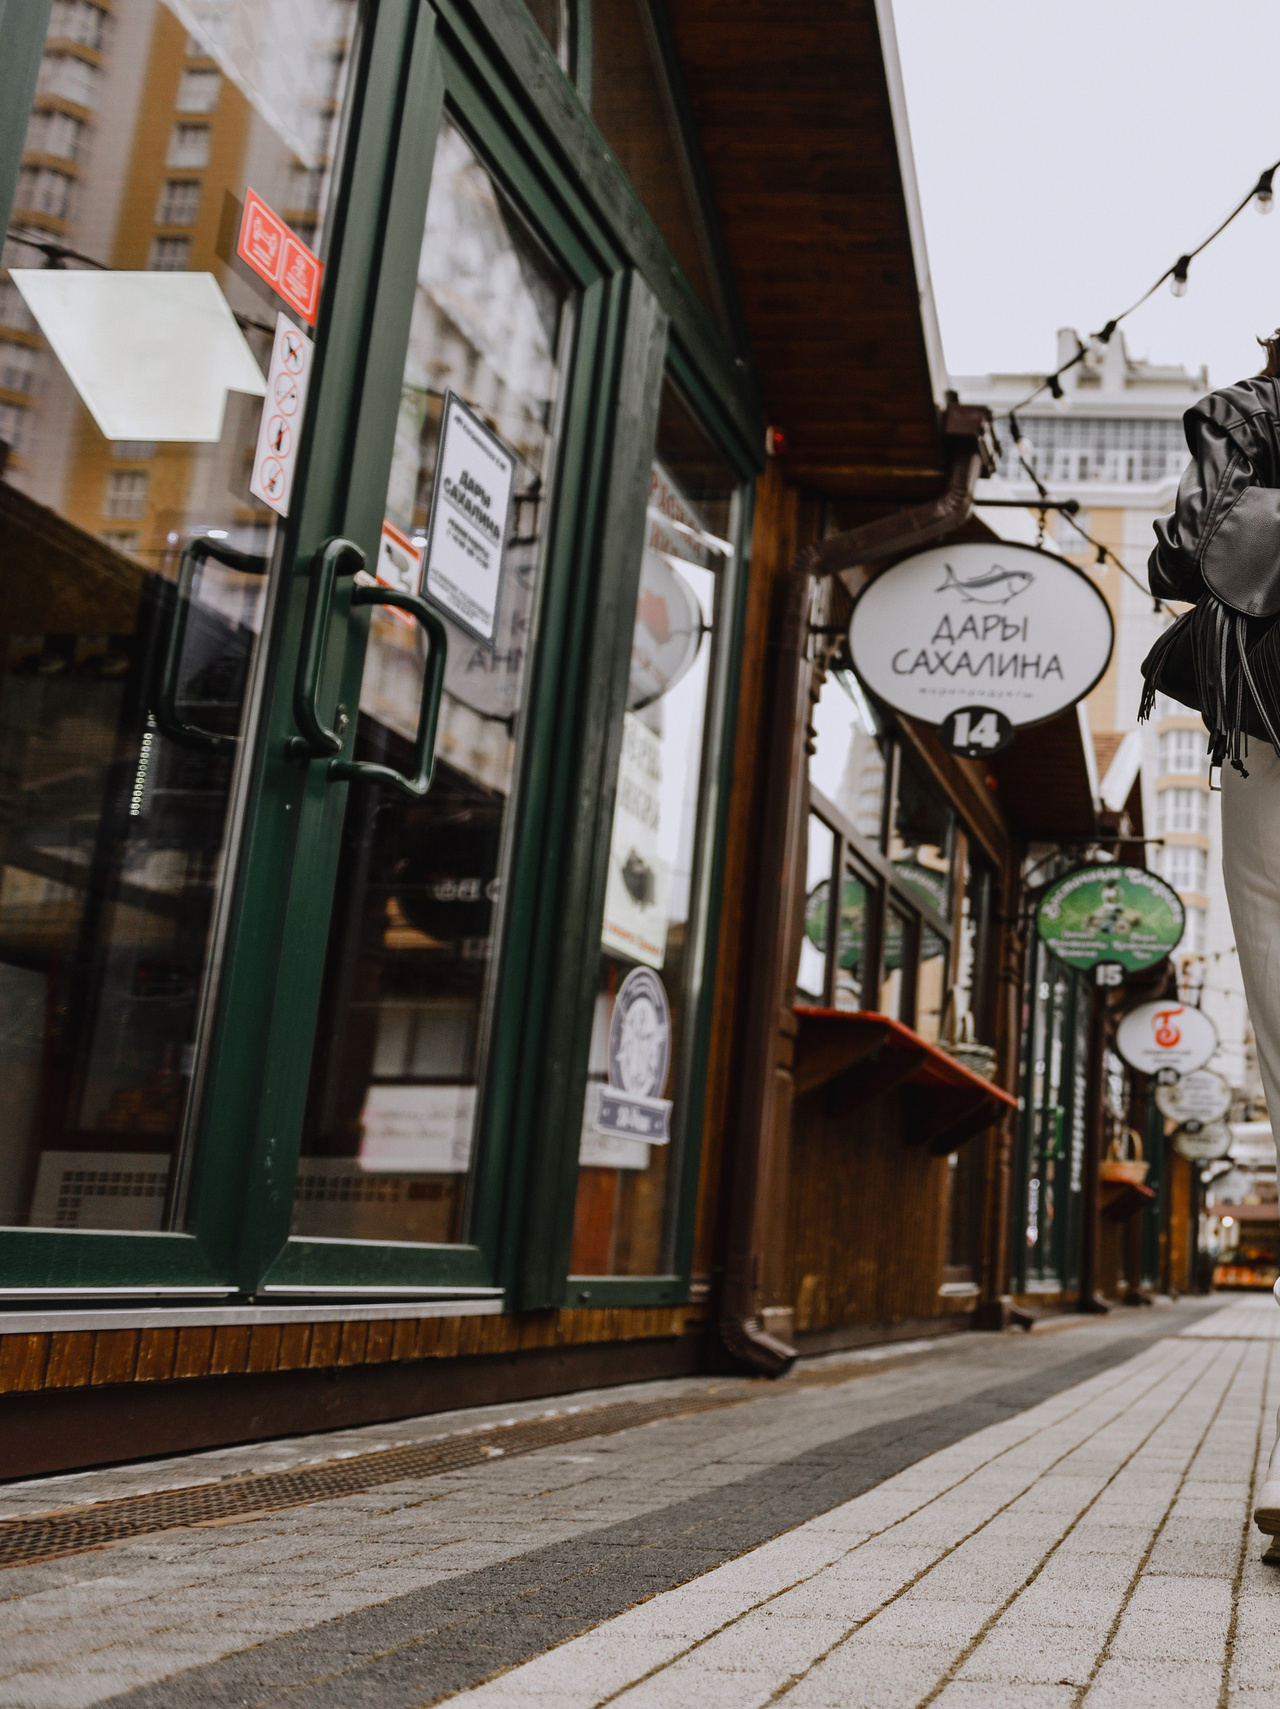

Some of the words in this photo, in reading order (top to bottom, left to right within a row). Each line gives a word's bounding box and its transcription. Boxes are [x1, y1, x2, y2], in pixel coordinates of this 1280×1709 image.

[458, 470, 491, 508] ДАРЫ
[931, 614, 1029, 645] ДАРЫ
[891, 648, 1064, 680] САХАЛИНА
[953, 712, 1000, 748] 14
[1095, 964, 1124, 986] 15
